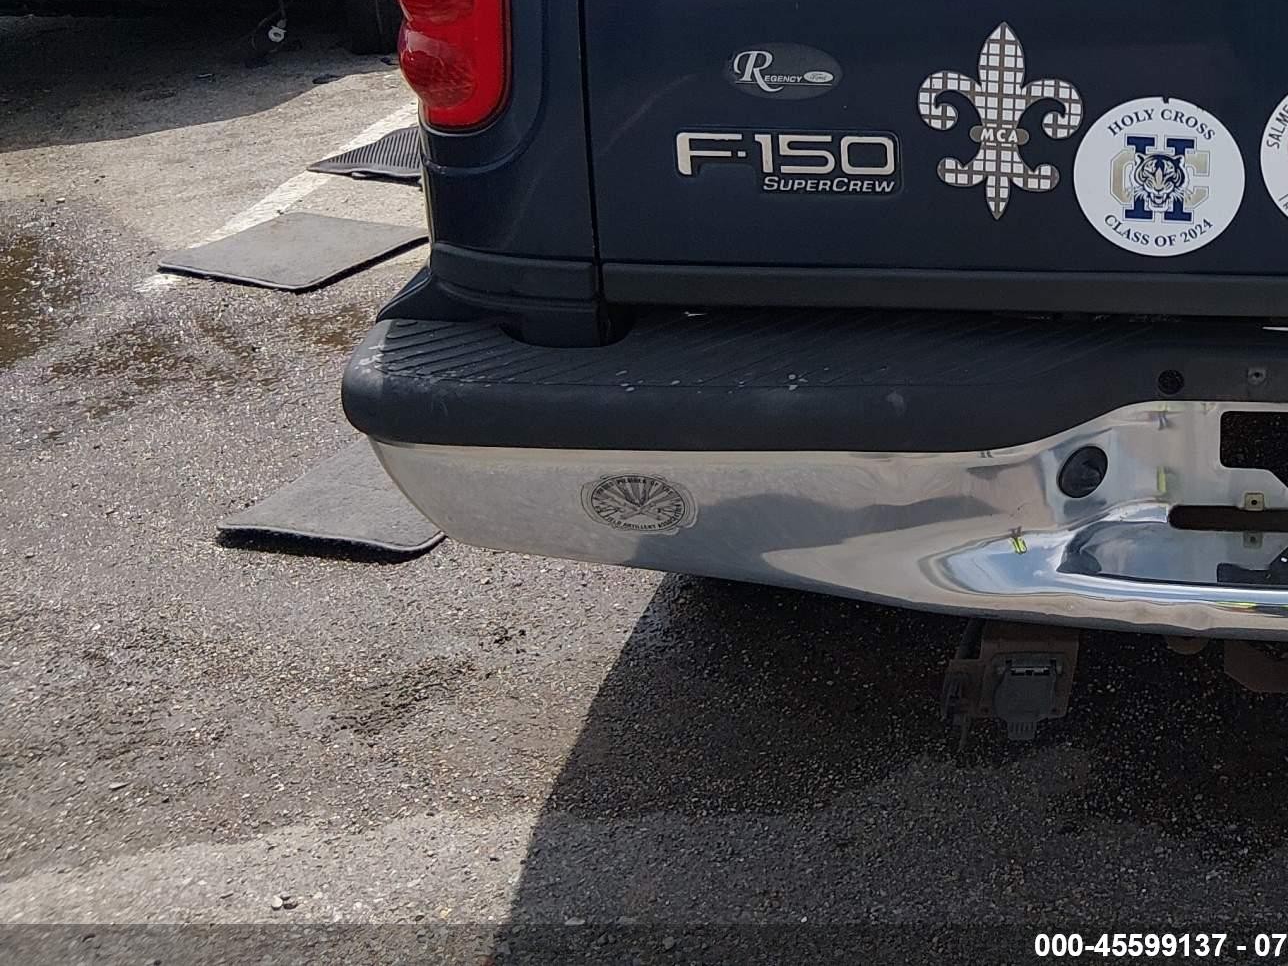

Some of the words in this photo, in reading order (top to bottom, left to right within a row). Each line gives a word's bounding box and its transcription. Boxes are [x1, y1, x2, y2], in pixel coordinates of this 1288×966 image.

[980, 128, 1018, 143] MCA
[1107, 108, 1155, 136] HOLY
[1160, 108, 1216, 140] CROSS
[676, 132, 895, 175] F-150
[1104, 214, 1150, 246] CLASS
[1154, 235, 1177, 247] OF
[1180, 217, 1214, 243] 2024
